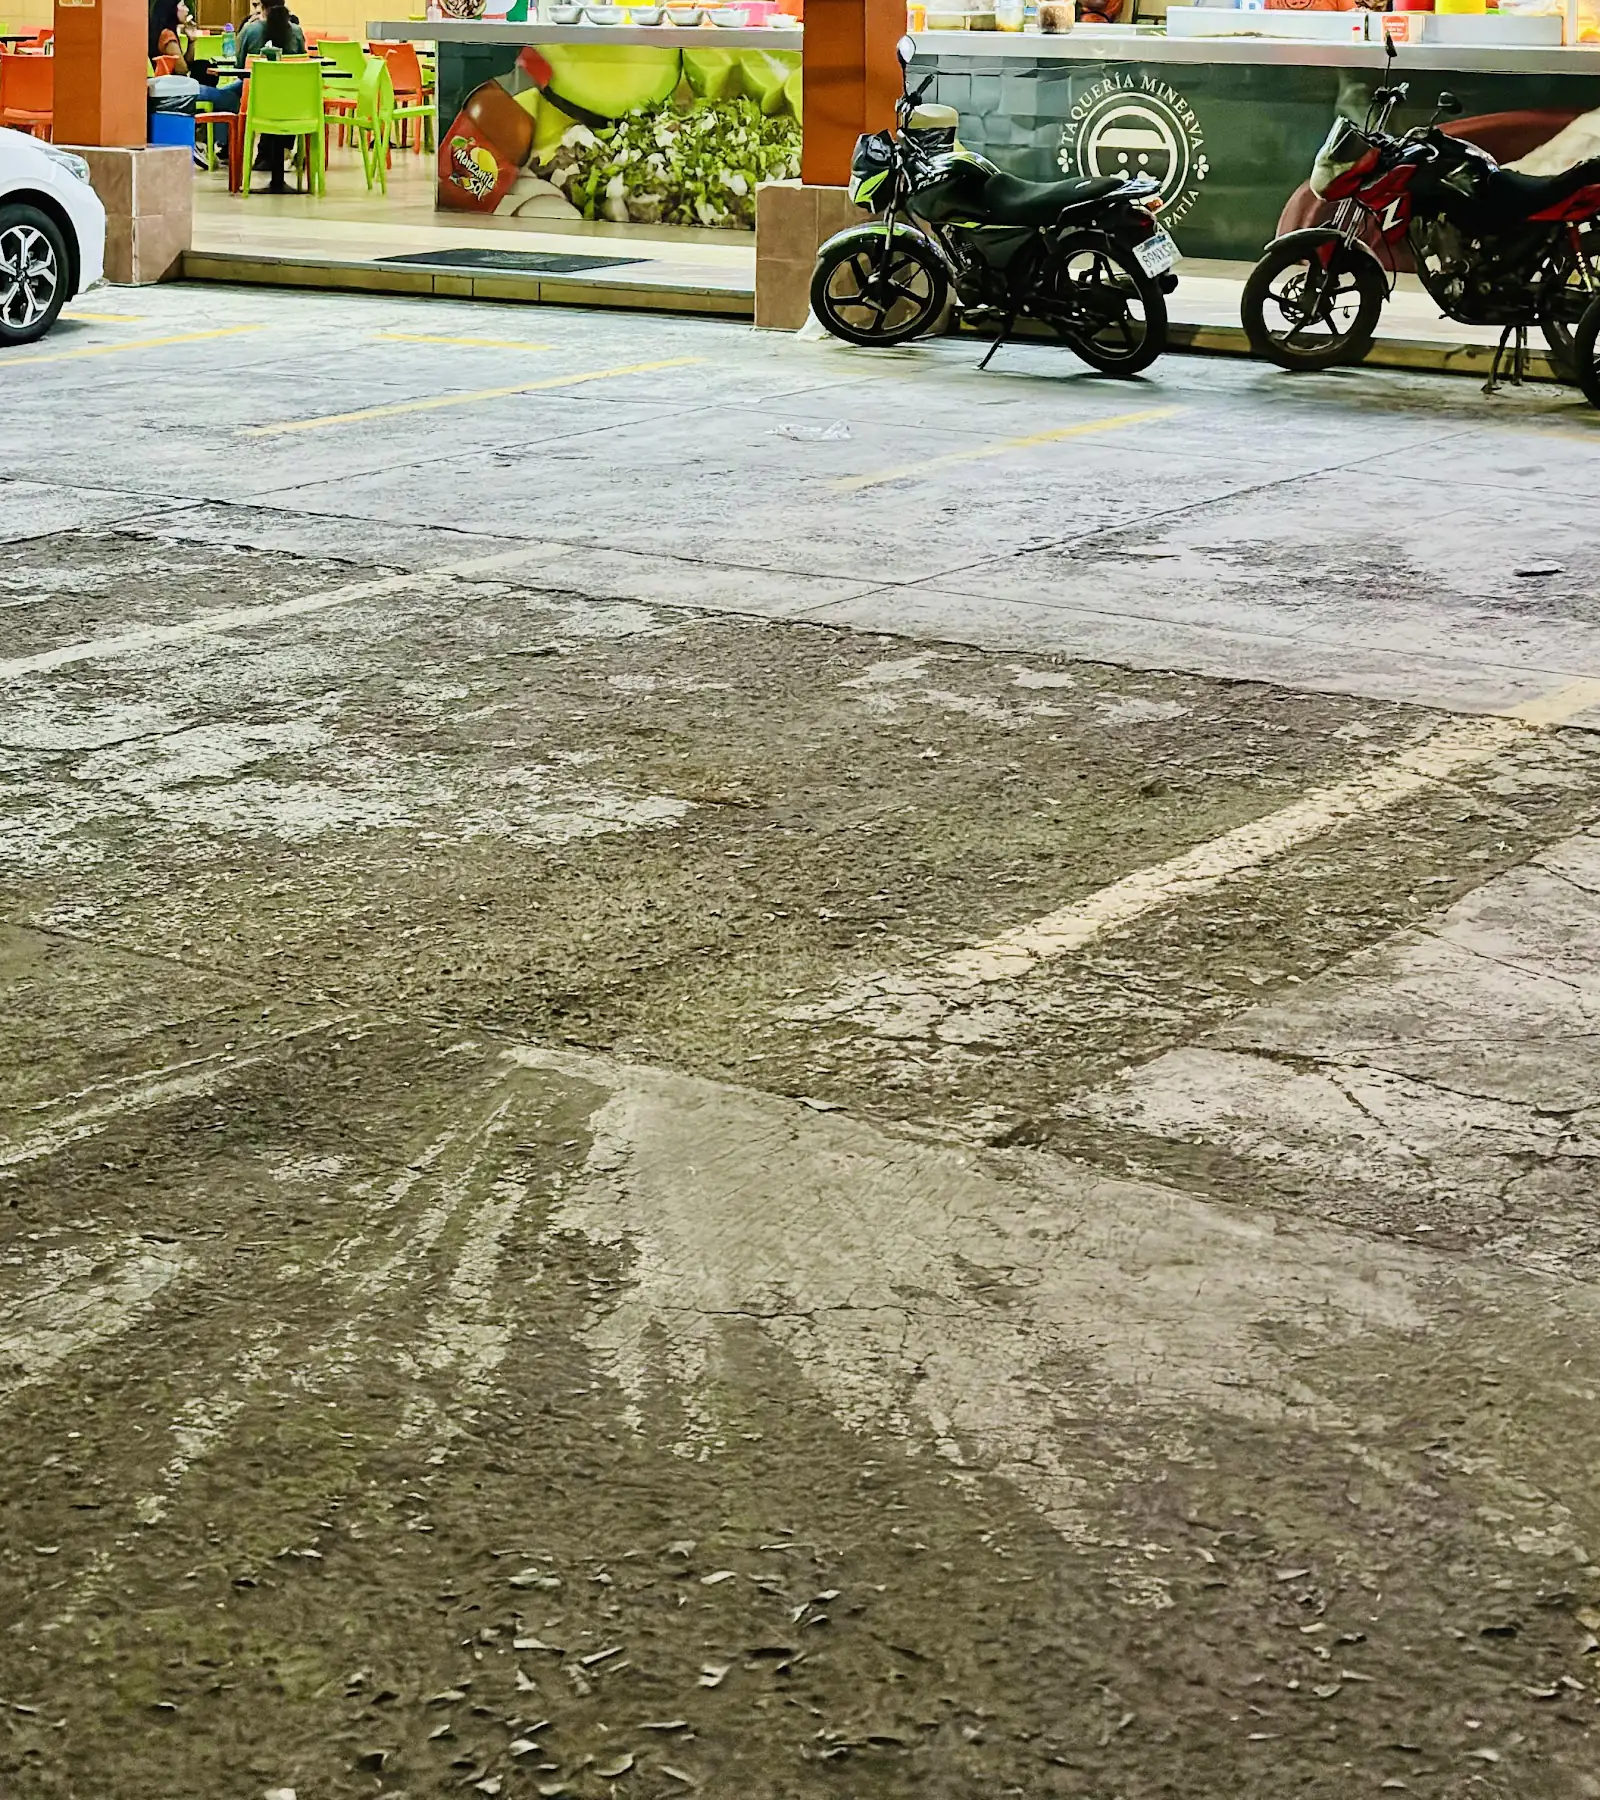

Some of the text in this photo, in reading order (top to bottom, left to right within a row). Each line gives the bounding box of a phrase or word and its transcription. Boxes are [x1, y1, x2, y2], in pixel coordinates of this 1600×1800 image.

[1061, 72, 1204, 150] TAQUERÍA MINERVA
[453, 149, 496, 190] Manzanita
[464, 178, 487, 201] Sol
[1154, 187, 1200, 236] APATÍA
